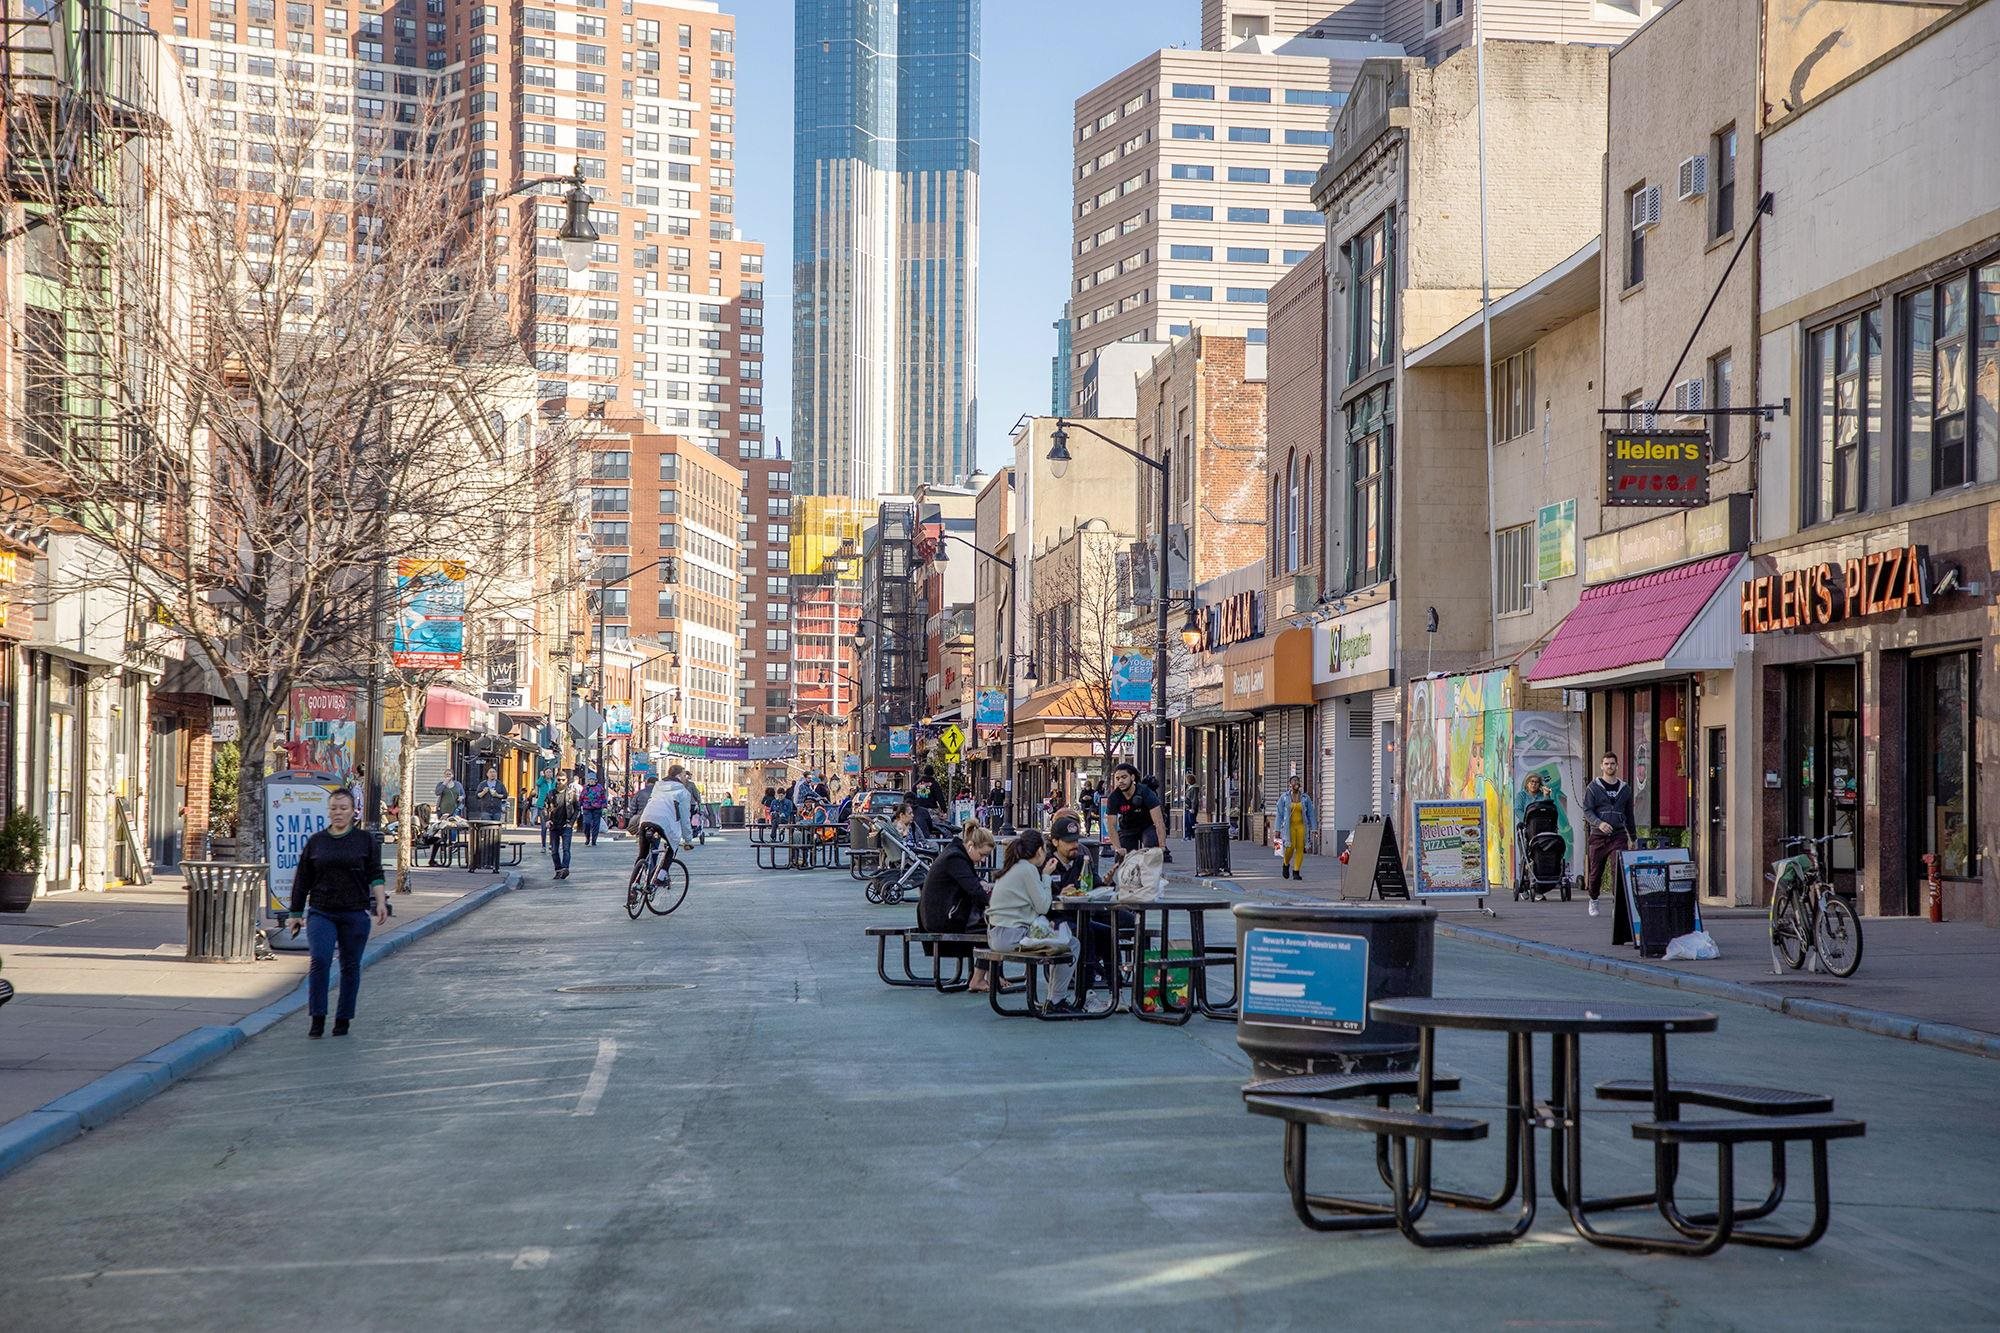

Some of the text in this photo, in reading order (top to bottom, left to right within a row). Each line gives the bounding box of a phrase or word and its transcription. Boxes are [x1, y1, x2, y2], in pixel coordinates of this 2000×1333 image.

[1617, 439, 1699, 460] Helen's
[1741, 544, 1923, 635] HELEN'S PIZZA
[426, 595, 464, 606] FEST
[308, 695, 326, 709] GOOD
[276, 815, 325, 833] SMAR
[1421, 820, 1460, 839] Helen's
[1423, 839, 1447, 850] PIZZA
[1262, 936, 1351, 951] Newark Avenue Pedestrian Mall
